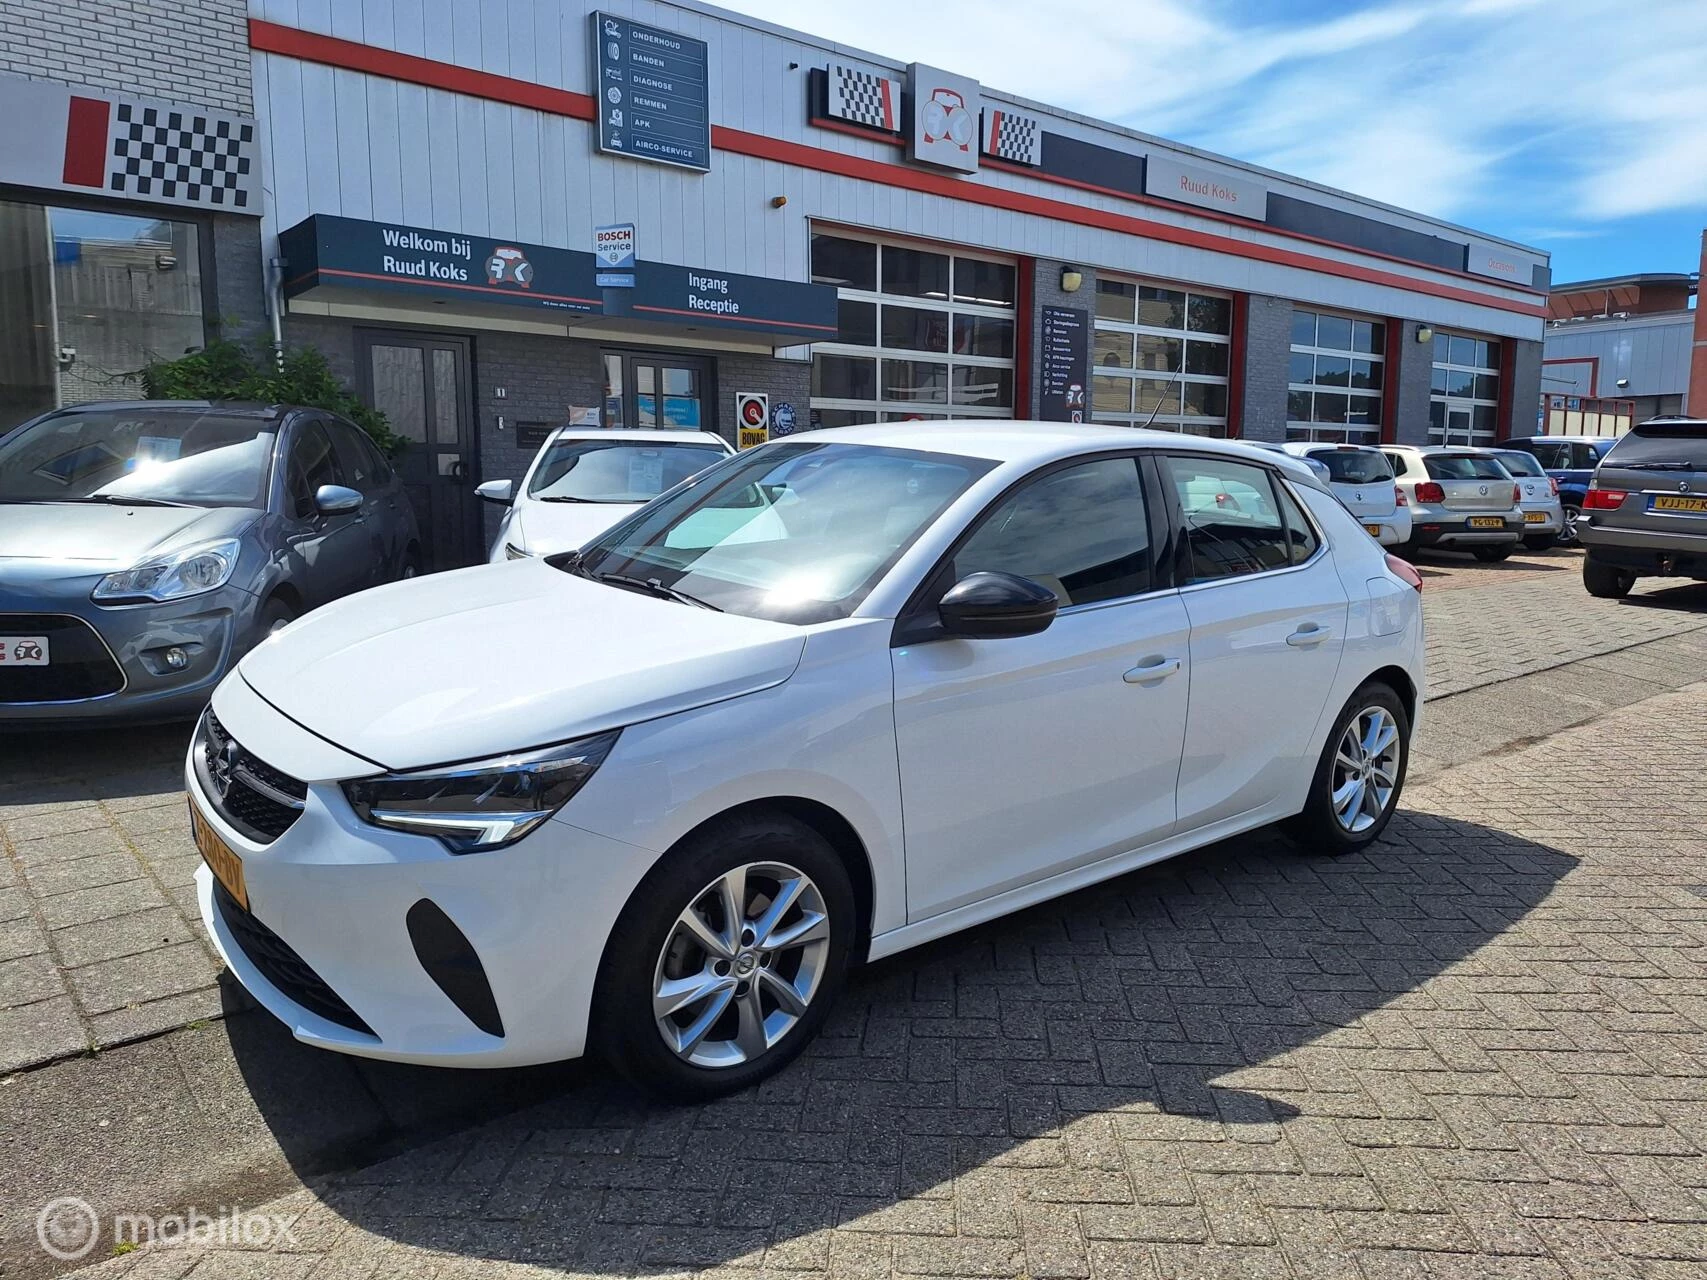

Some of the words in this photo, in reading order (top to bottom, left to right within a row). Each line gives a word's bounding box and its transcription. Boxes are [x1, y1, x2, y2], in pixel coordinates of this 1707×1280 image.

[632, 31, 681, 50] ONDERHOUD
[632, 53, 665, 68] BANDEN
[633, 75, 673, 91] DIAGNOSE
[633, 96, 667, 111] REMMEN
[634, 118, 651, 129] APK
[635, 139, 693, 158] AIRCO-SERVICE
[1180, 175, 1208, 195] Ruud
[1212, 183, 1237, 202] Koks
[382, 228, 448, 254] Welkom
[451, 238, 471, 261] bij
[597, 230, 631, 242] BOSCH
[597, 242, 631, 252] Service
[383, 255, 426, 276] Ruud
[429, 261, 468, 282] Koks
[688, 272, 728, 294] Ingang
[688, 294, 739, 315] Receptie
[742, 431, 765, 446] BOVAG
